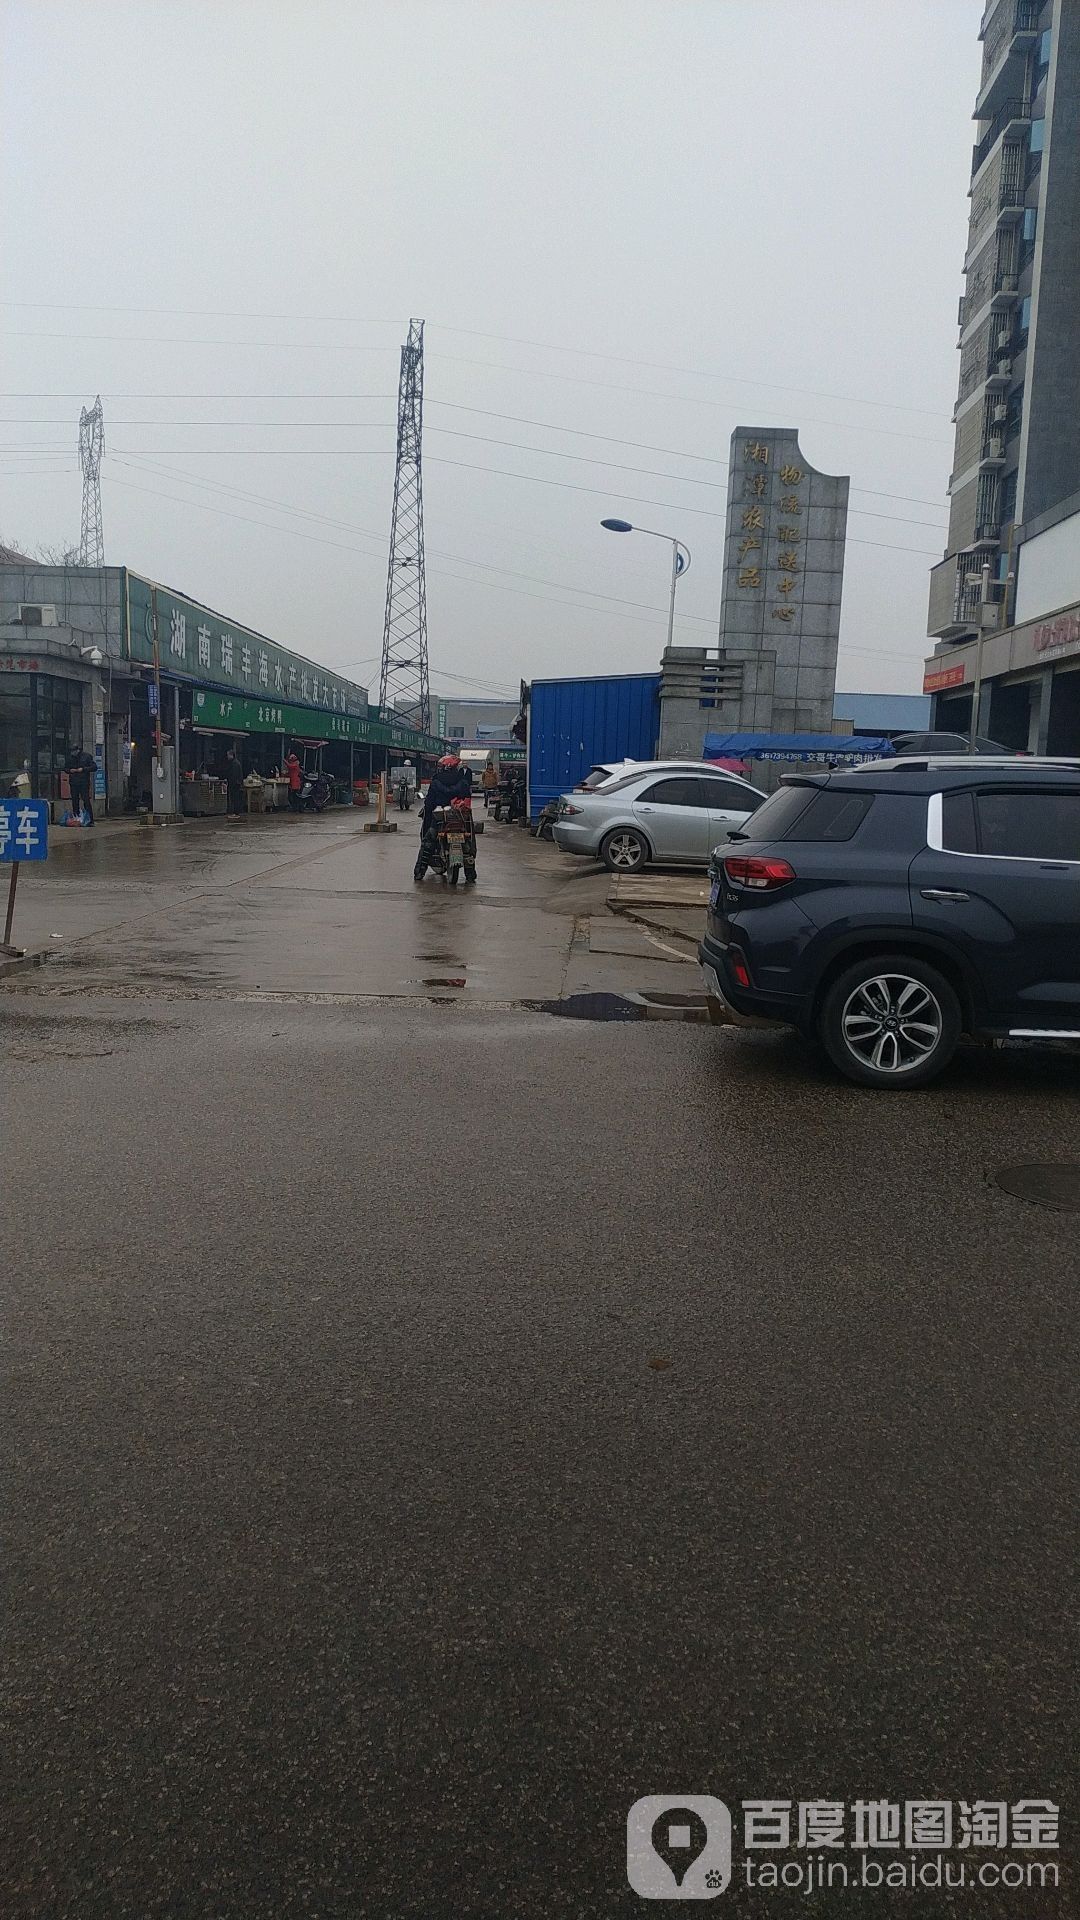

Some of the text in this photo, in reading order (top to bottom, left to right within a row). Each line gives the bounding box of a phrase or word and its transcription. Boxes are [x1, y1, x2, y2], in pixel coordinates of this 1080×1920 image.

[738, 441, 769, 588] 湘潭农产品
[771, 464, 802, 622] 物流配送中心
